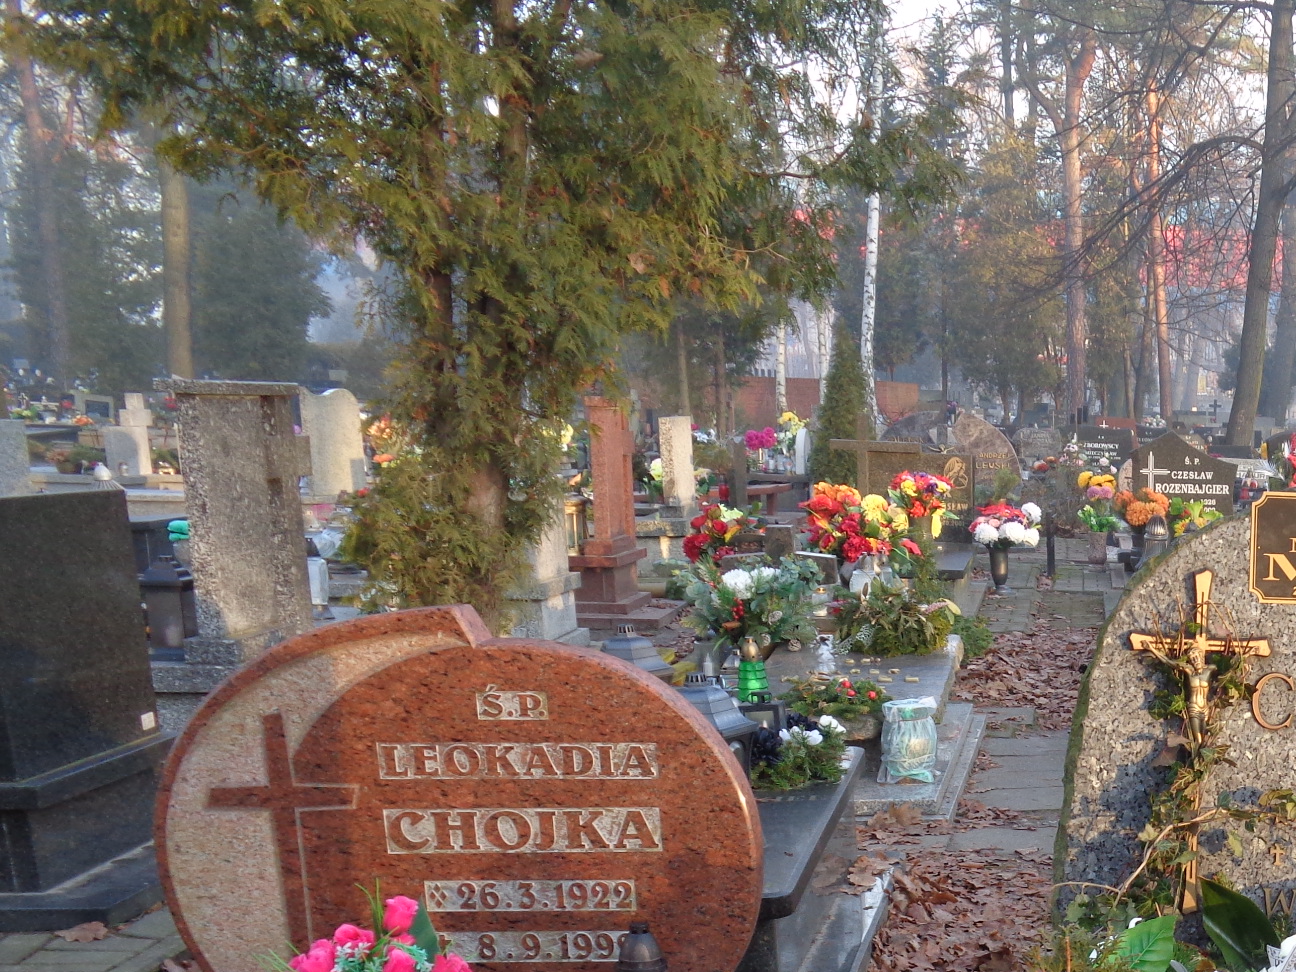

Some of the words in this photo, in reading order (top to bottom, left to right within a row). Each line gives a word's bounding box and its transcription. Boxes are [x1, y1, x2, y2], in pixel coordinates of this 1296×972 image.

[1155, 483, 1230, 495] ROZENBAJGIER
[1171, 471, 1214, 480] CZESŁAW
[480, 684, 546, 718] Ś.P.
[380, 744, 656, 778] LEOKADIA
[387, 810, 661, 851] CHOJKA
[456, 882, 633, 910] 26.3.1922
